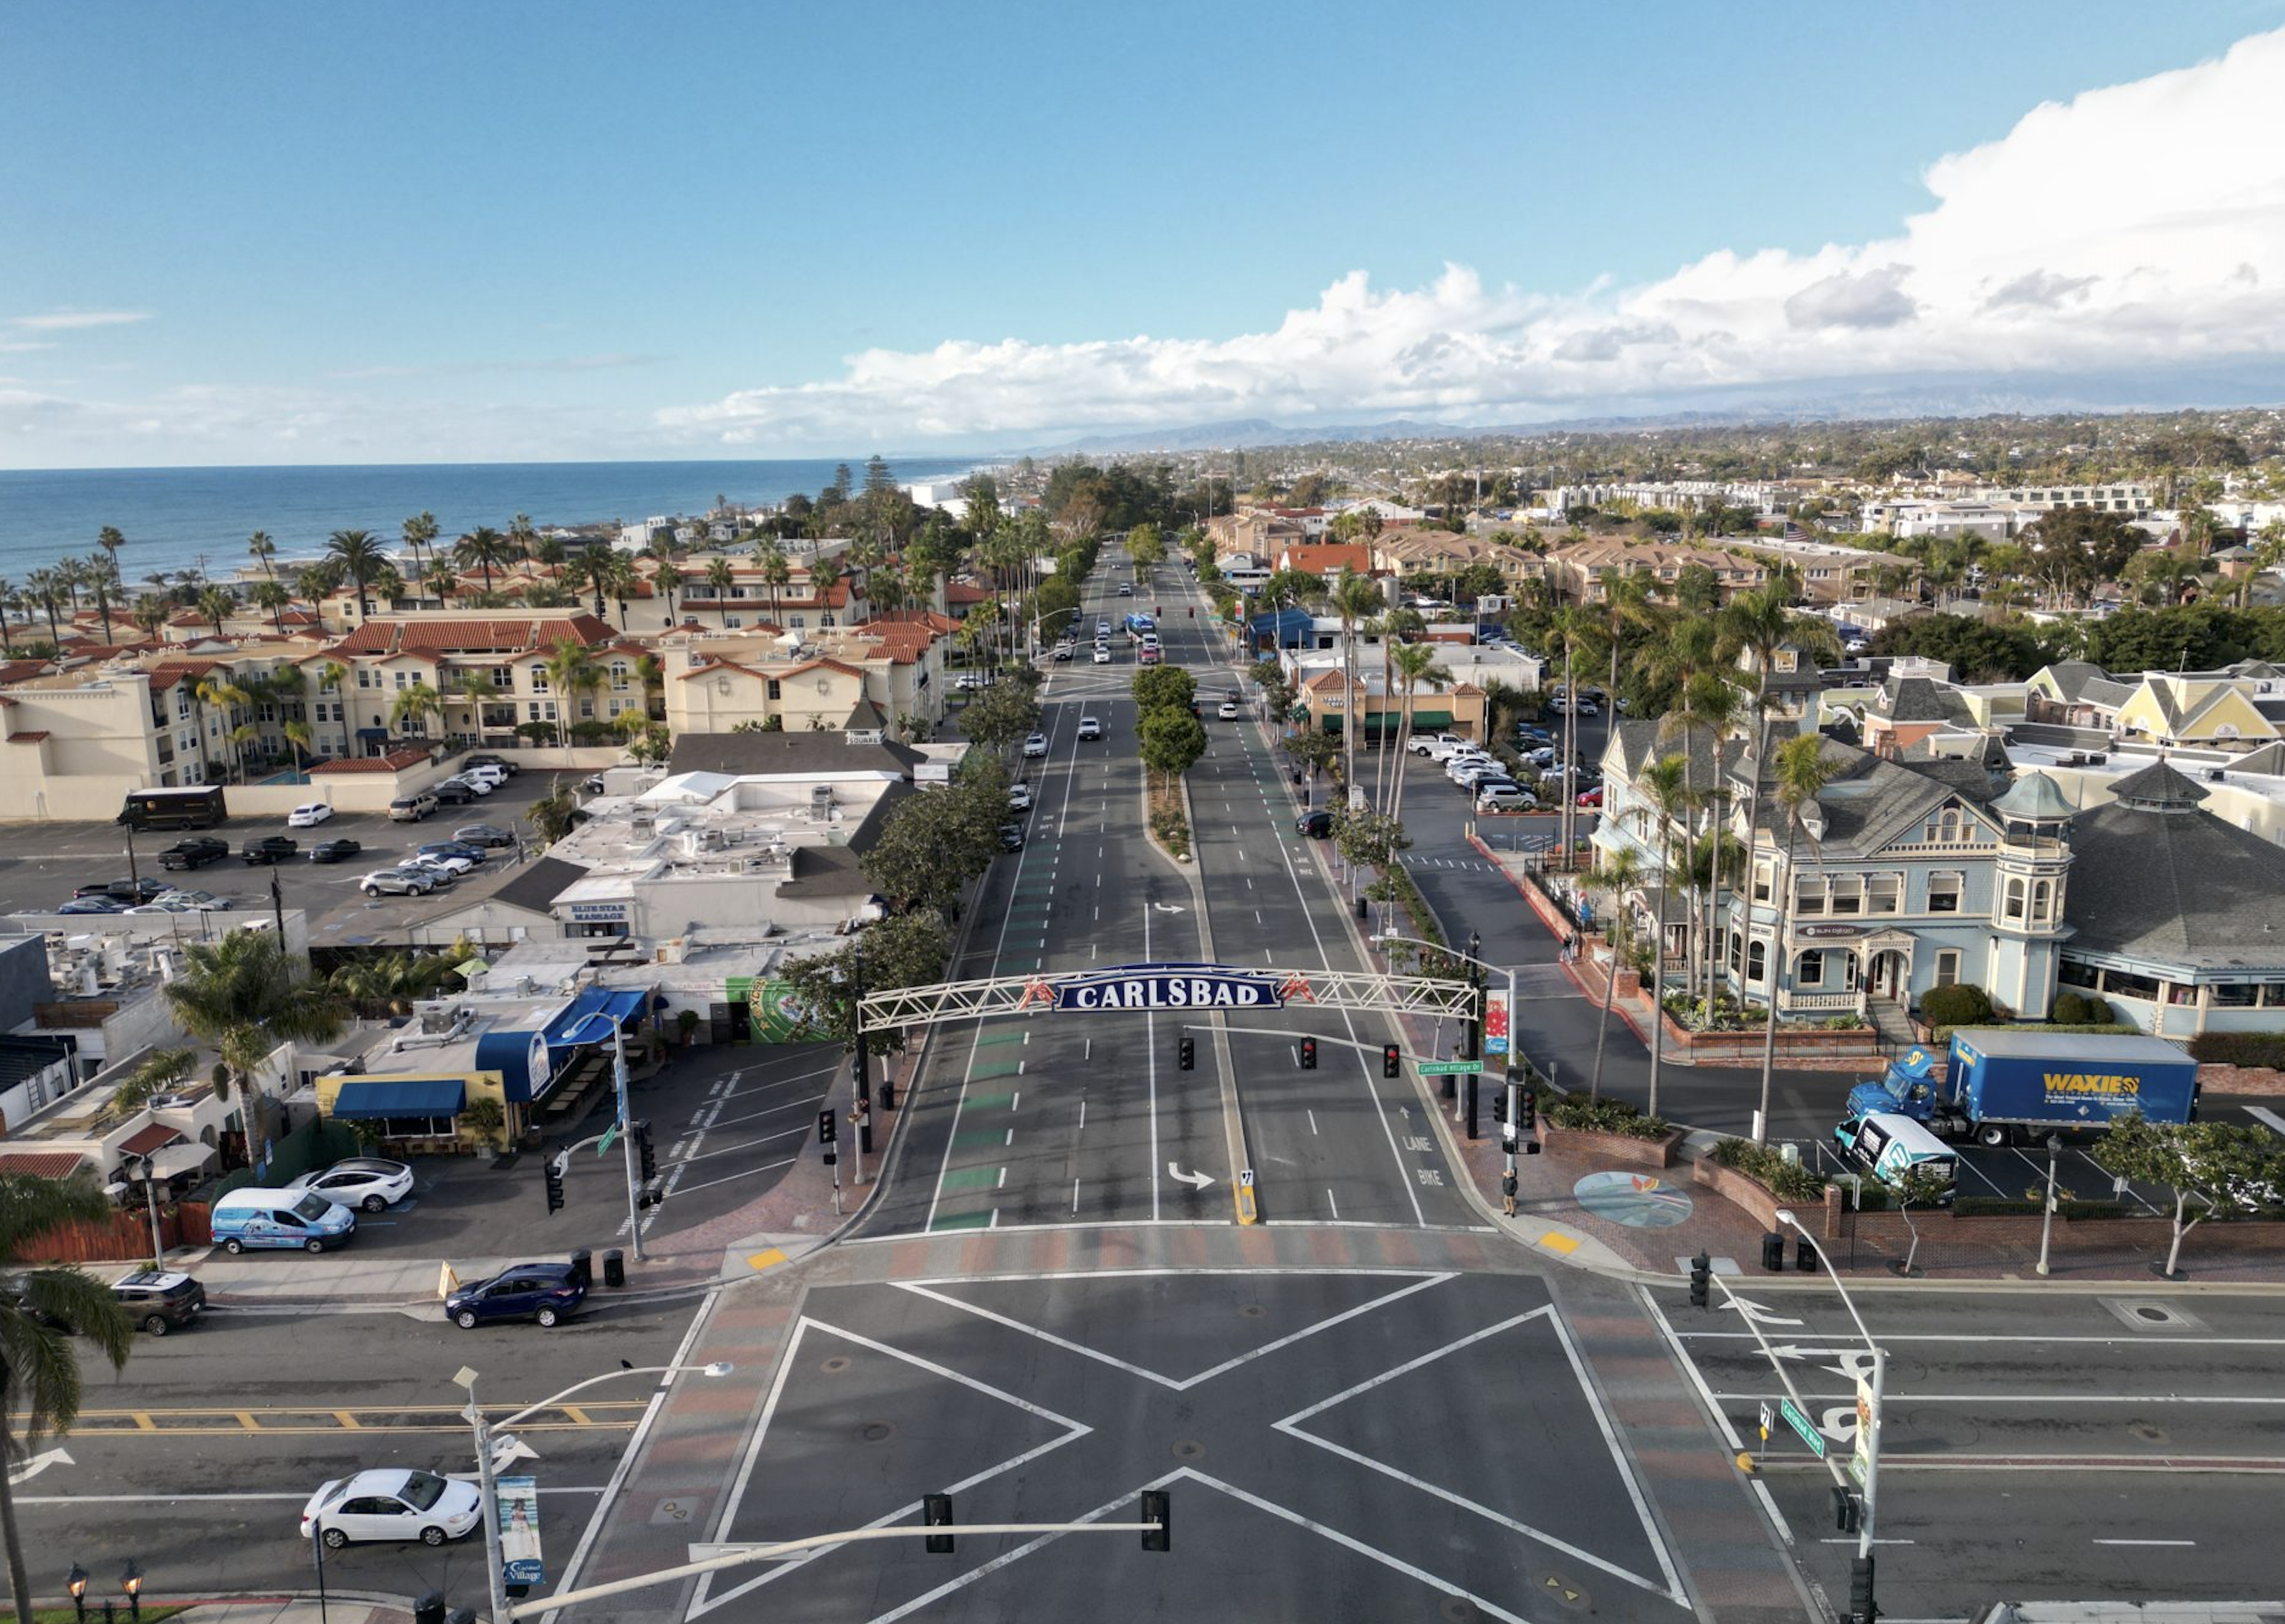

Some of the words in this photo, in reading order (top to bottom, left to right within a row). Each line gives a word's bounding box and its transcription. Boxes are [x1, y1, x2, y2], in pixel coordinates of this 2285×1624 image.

[1076, 978, 1259, 1008] CARLSBAD
[1420, 1064, 1447, 1073] Carlsbad
[1449, 1064, 1471, 1073] Village
[2043, 1074, 2122, 1092] WAXIE
[1402, 1136, 1433, 1152] LANE
[1417, 1168, 1444, 1186] BIKE
[1783, 1404, 1807, 1435] Carlsbad
[1808, 1432, 1821, 1451] Blvd
[509, 1570, 541, 1582] Village
